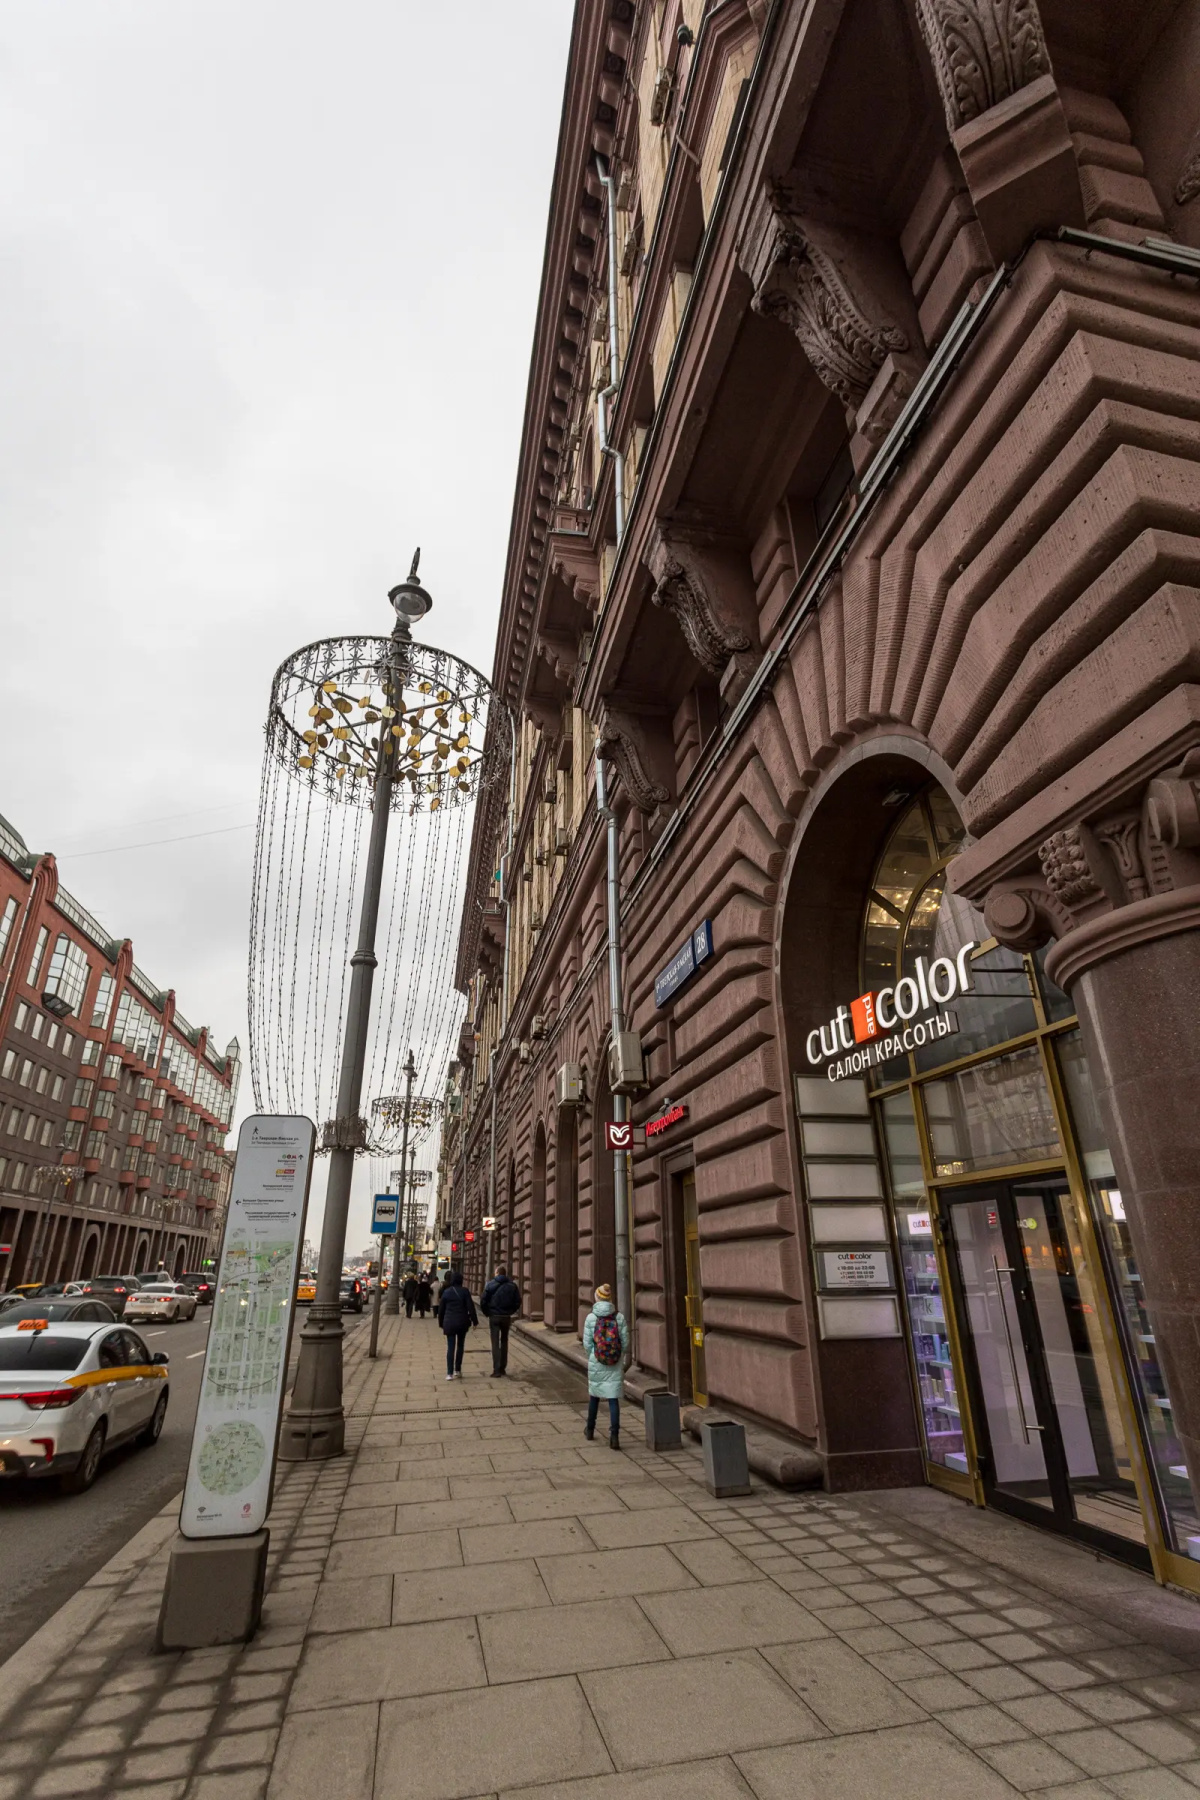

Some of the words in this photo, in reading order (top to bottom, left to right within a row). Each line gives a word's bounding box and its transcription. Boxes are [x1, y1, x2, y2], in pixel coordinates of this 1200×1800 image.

[696, 931, 706, 953] 28
[806, 1005, 853, 1064] cut
[862, 995, 877, 1035] and
[876, 941, 980, 1029] color
[827, 1048, 871, 1082] САЛОН
[875, 1011, 951, 1062] КРАСОТЫ
[854, 1252, 872, 1260] color
